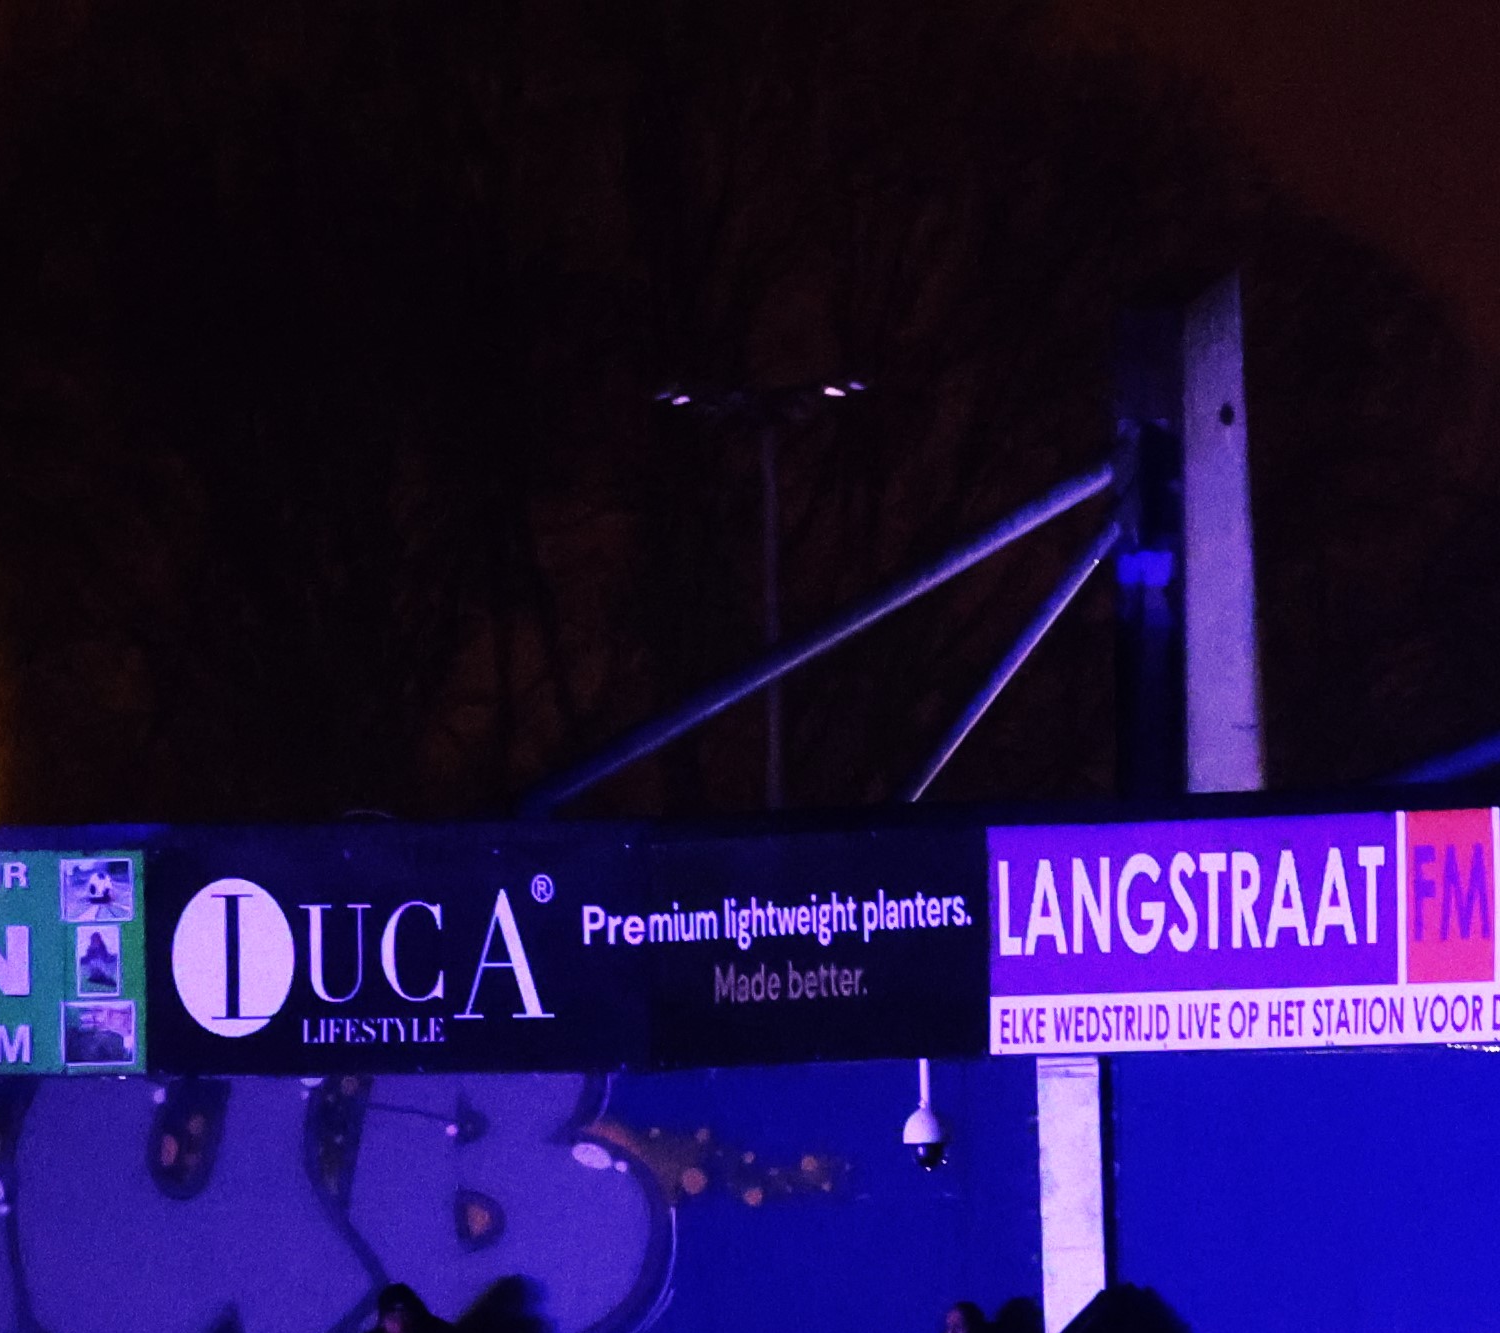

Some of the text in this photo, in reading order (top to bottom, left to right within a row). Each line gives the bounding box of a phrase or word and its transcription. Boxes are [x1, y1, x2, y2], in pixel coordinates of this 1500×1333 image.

[582, 888, 972, 950] Premium lightweight planters.
[999, 845, 1385, 956] LANGSTRAAT
[1412, 844, 1490, 941] FM
[713, 960, 868, 1003] Made better.
[303, 1017, 445, 1044] LIFESTYLE
[1000, 1007, 1046, 1044] ELKE
[1053, 1005, 1170, 1043] WEDSTRIJD
[1177, 1002, 1222, 1040] LIVE
[1228, 1001, 1260, 1038] OP
[1267, 1000, 1305, 1037] HET
[1313, 996, 1402, 1036] STATION
[1412, 994, 1484, 1033] VOOR
